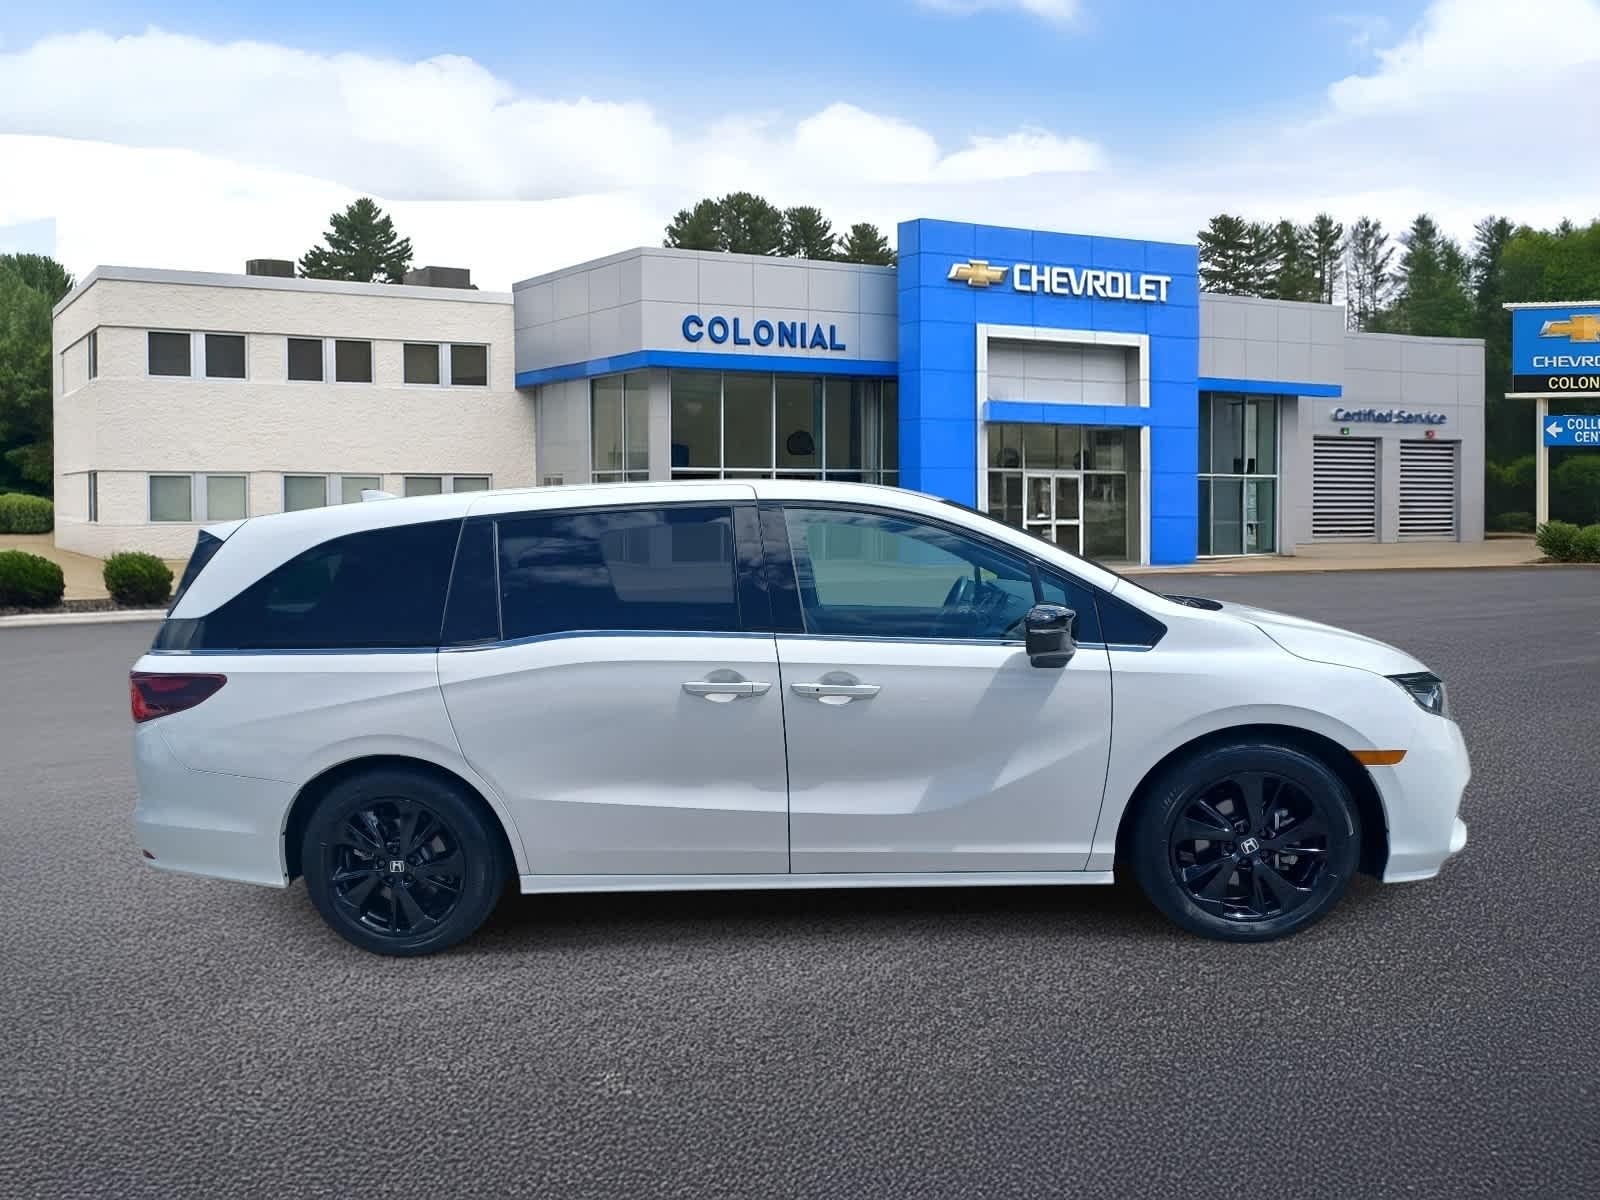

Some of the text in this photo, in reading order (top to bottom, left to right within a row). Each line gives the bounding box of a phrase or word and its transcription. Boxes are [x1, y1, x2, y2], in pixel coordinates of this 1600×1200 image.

[1013, 263, 1172, 302] CHEVROLET
[682, 315, 846, 351] COLONIAL
[1548, 376, 1600, 389] COLON
[1333, 408, 1447, 425] Certified Service
[1574, 431, 1600, 443] CEN
